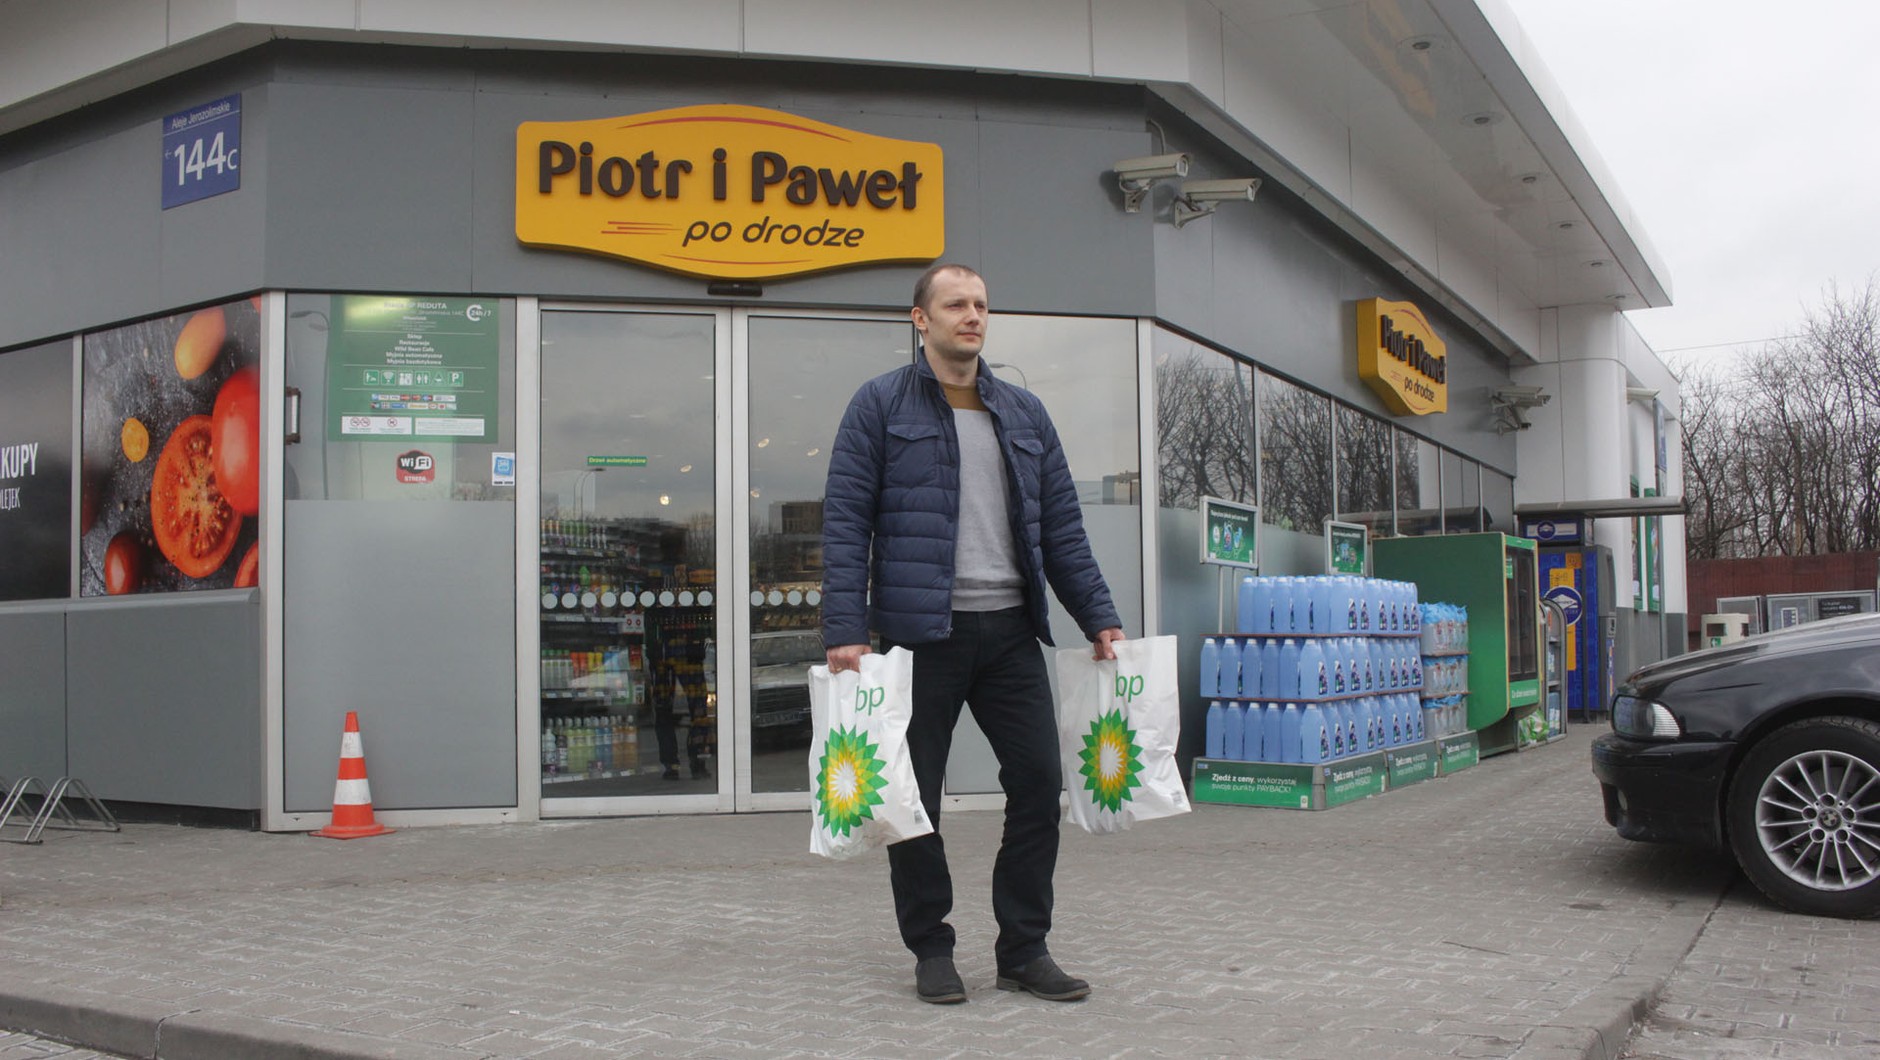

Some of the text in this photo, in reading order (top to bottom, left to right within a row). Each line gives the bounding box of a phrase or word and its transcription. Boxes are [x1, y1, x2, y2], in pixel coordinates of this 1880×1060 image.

[171, 101, 230, 130] Aleje Jerozolimskie
[538, 140, 923, 210] Piotr i Paweł
[682, 215, 865, 248] po drodze
[417, 302, 447, 310] REDUTA
[1380, 314, 1408, 362] Piotr
[1404, 376, 1434, 403] po drodze
[0, 442, 38, 479] KUPY
[0, 486, 21, 511] LEJEK
[854, 685, 885, 716] bp
[1115, 670, 1144, 702] bp
[1232, 784, 1255, 792] punkty
[1256, 776, 1297, 786] wykorzystaj
